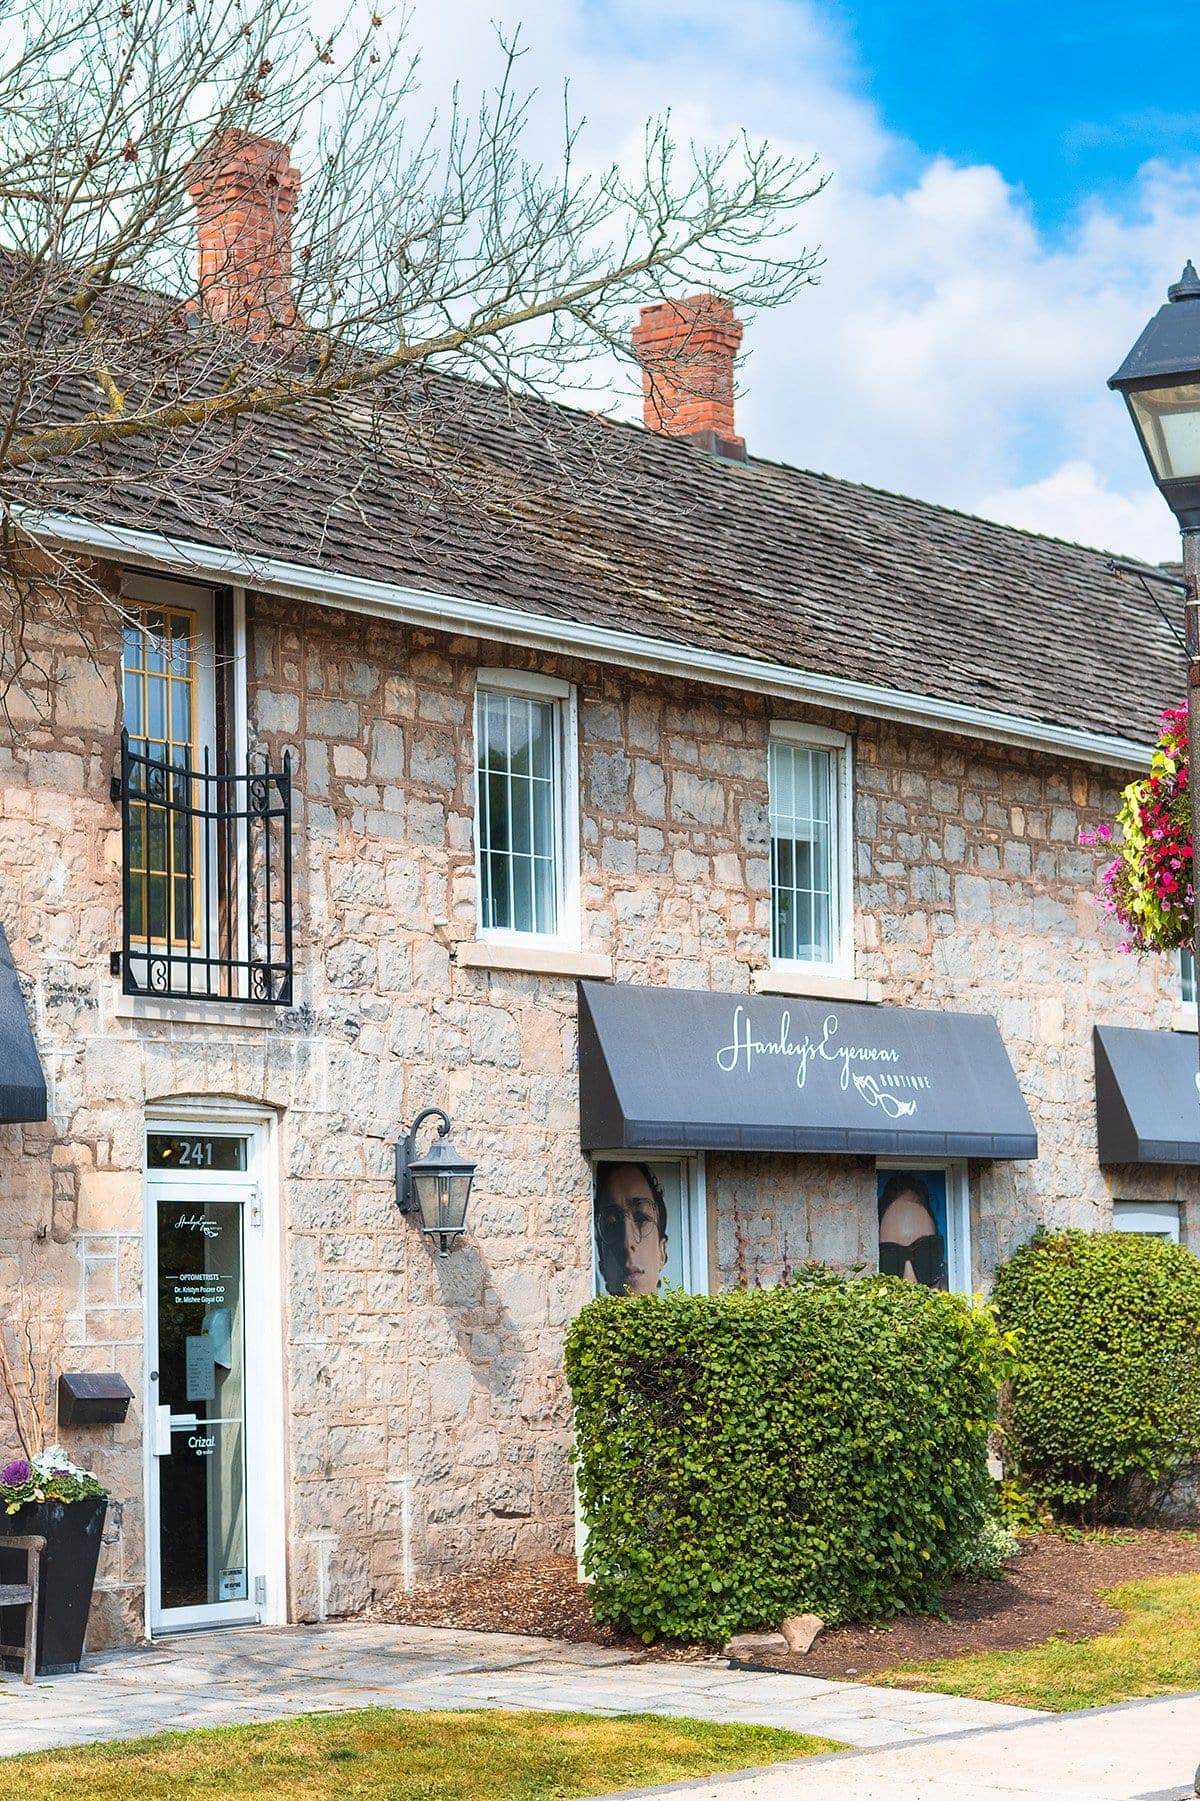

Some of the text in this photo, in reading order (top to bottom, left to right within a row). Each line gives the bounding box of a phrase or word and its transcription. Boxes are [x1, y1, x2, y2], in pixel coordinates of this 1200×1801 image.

[716, 1005, 900, 1091] Hanley's Eyewear
[879, 1073, 932, 1091] BOUTIQUE
[178, 1142, 213, 1166] 241
[179, 1273, 220, 1281] OPTOMETRISTS
